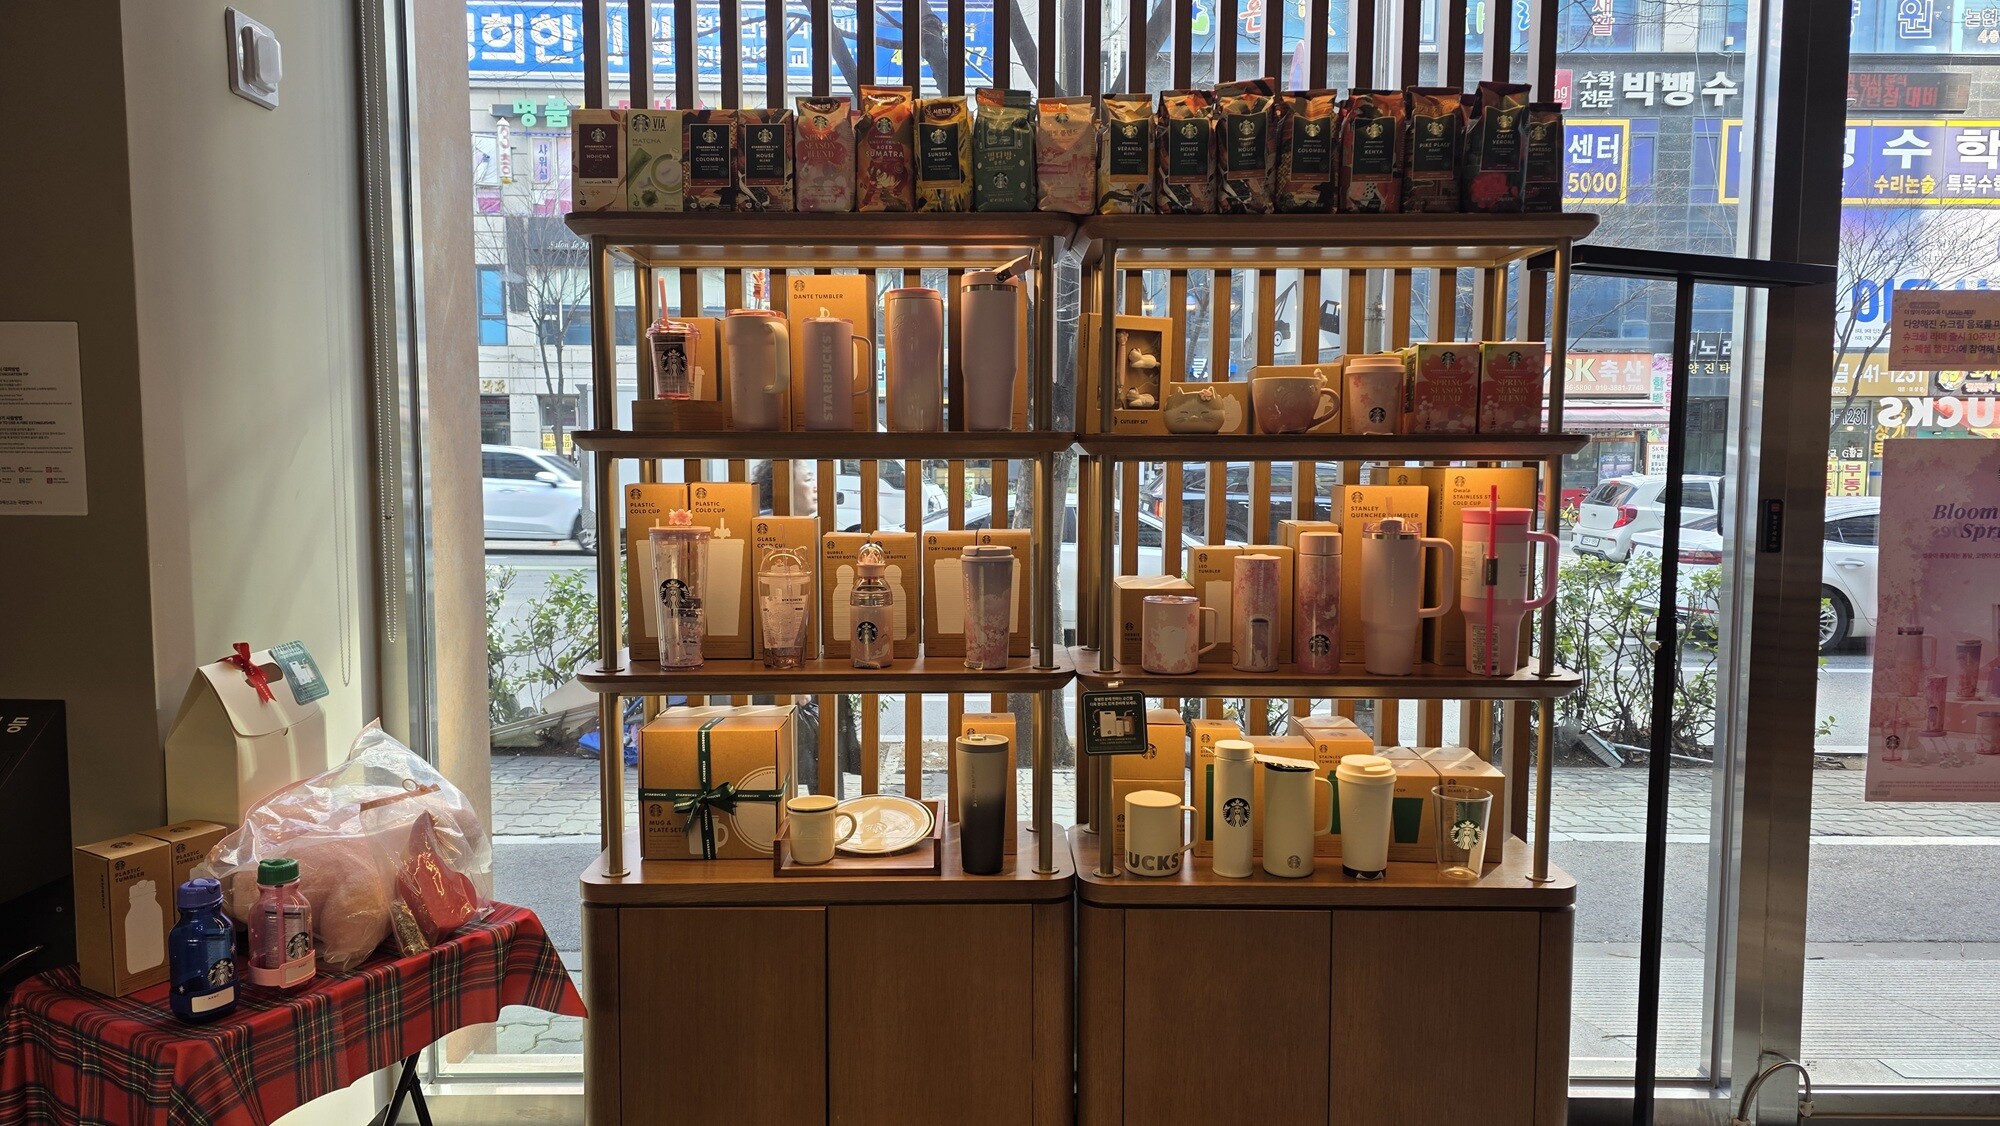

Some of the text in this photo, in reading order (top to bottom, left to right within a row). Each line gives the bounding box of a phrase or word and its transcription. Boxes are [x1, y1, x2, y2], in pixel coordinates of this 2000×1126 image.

[1580, 71, 1616, 89] 수학
[1622, 71, 1738, 107] 박뱅수
[1580, 90, 1615, 108] 전문
[1905, 87, 1938, 107] 대비
[513, 97, 570, 128] 명품
[653, 118, 666, 129] VIA
[865, 150, 904, 158] SUMATRA
[1567, 133, 1619, 165] 센터
[538, 144, 548, 181] 샤워실
[1874, 175, 1936, 194] 수리논술
[1903, 320, 1937, 329] 다양해진
[1939, 320, 1964, 329] 슈크림
[1968, 332, 1995, 341] 10주년
[823, 334, 833, 421] STARBUCKS
[1599, 360, 1645, 383] 축산
[1932, 503, 1998, 520] Bloom
[176, 850, 200, 861] PLASTIC
[176, 854, 204, 866] TUMBLER
[1125, 852, 1179, 871] UCKS
[114, 866, 141, 879] PLASTIC
[114, 871, 145, 883] TUMBLER
